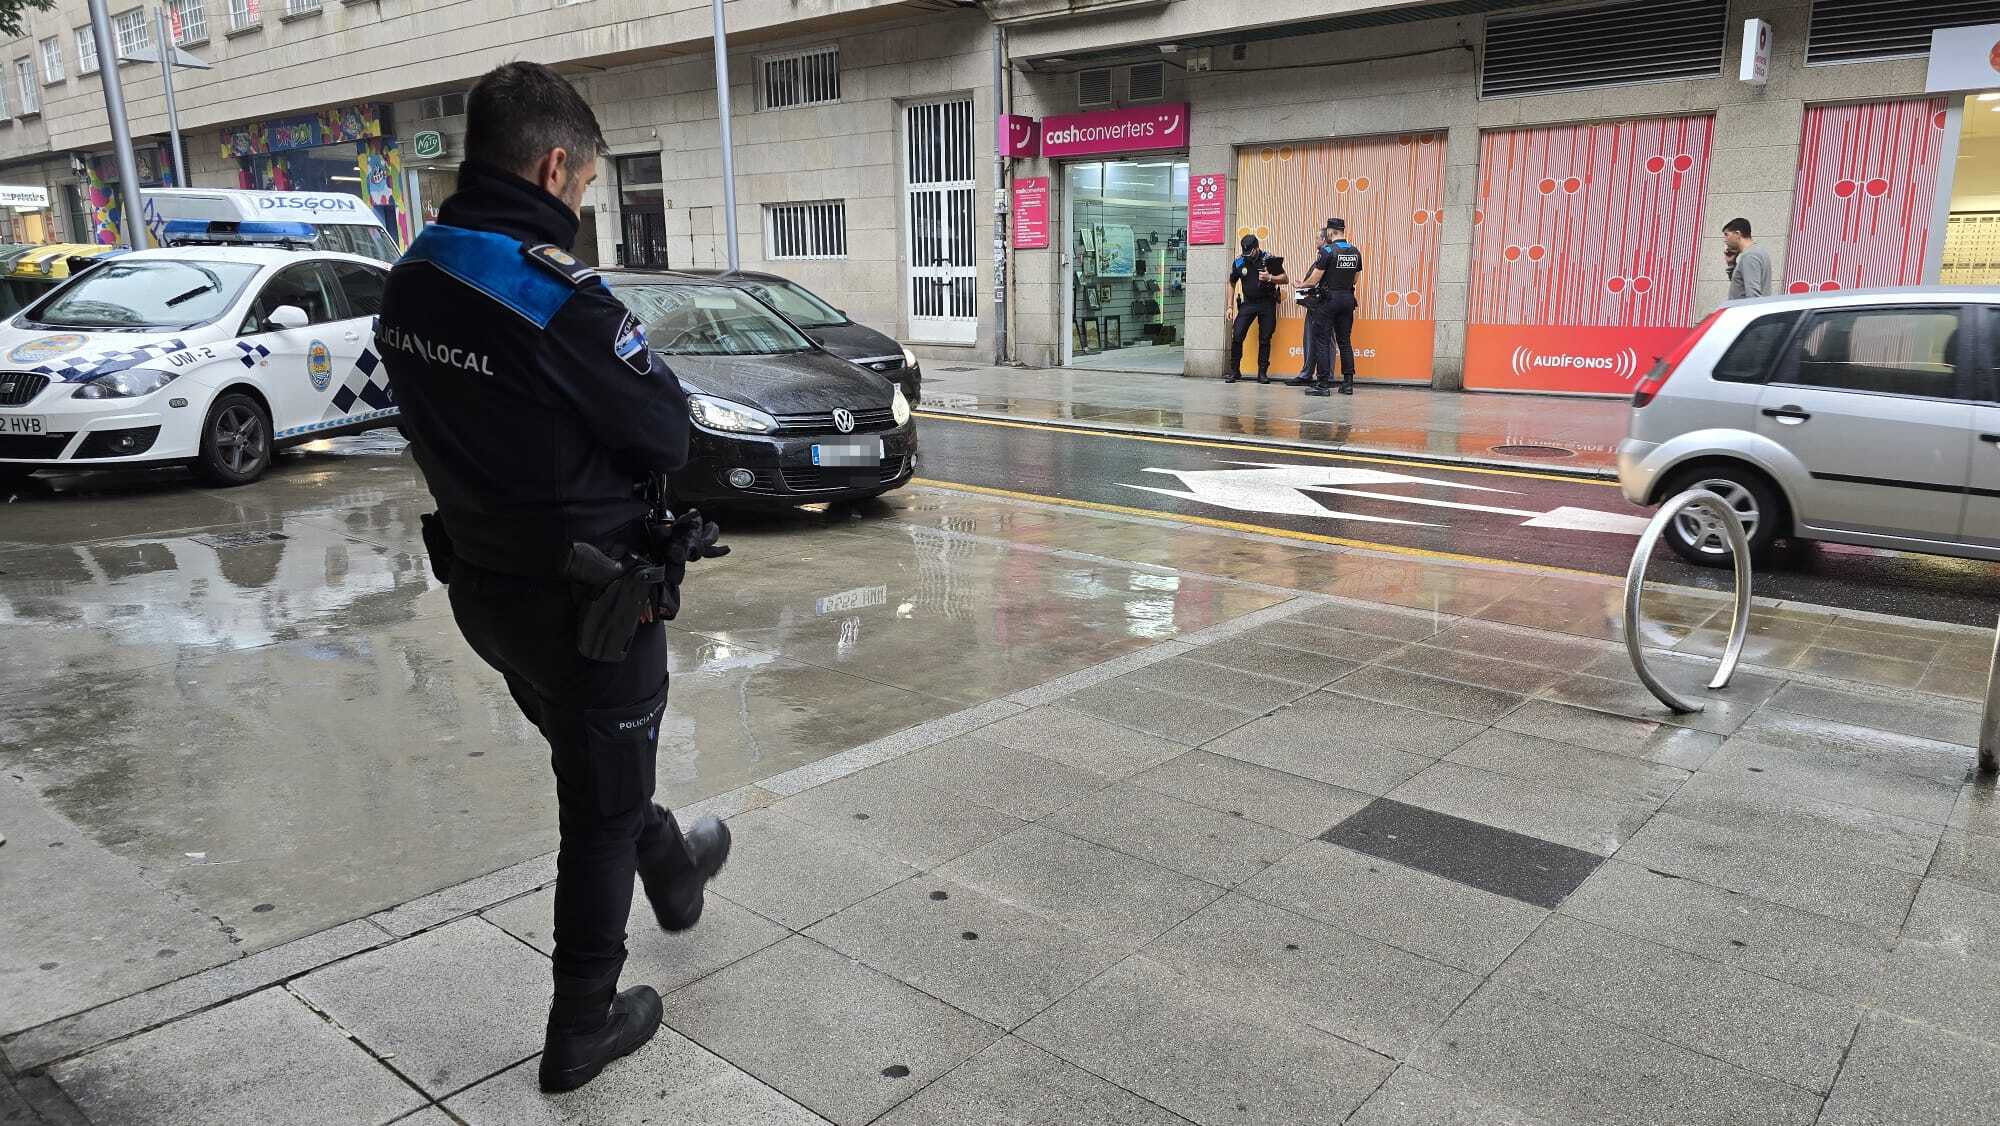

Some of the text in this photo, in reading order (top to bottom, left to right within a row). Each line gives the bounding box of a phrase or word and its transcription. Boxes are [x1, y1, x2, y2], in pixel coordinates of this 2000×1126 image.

[1046, 121, 1154, 145] cashconverters
[259, 196, 356, 210] DISGON
[427, 340, 495, 376] LOCAL
[1533, 354, 1613, 369] AUDÍFONOS
[11, 418, 42, 432] HVB
